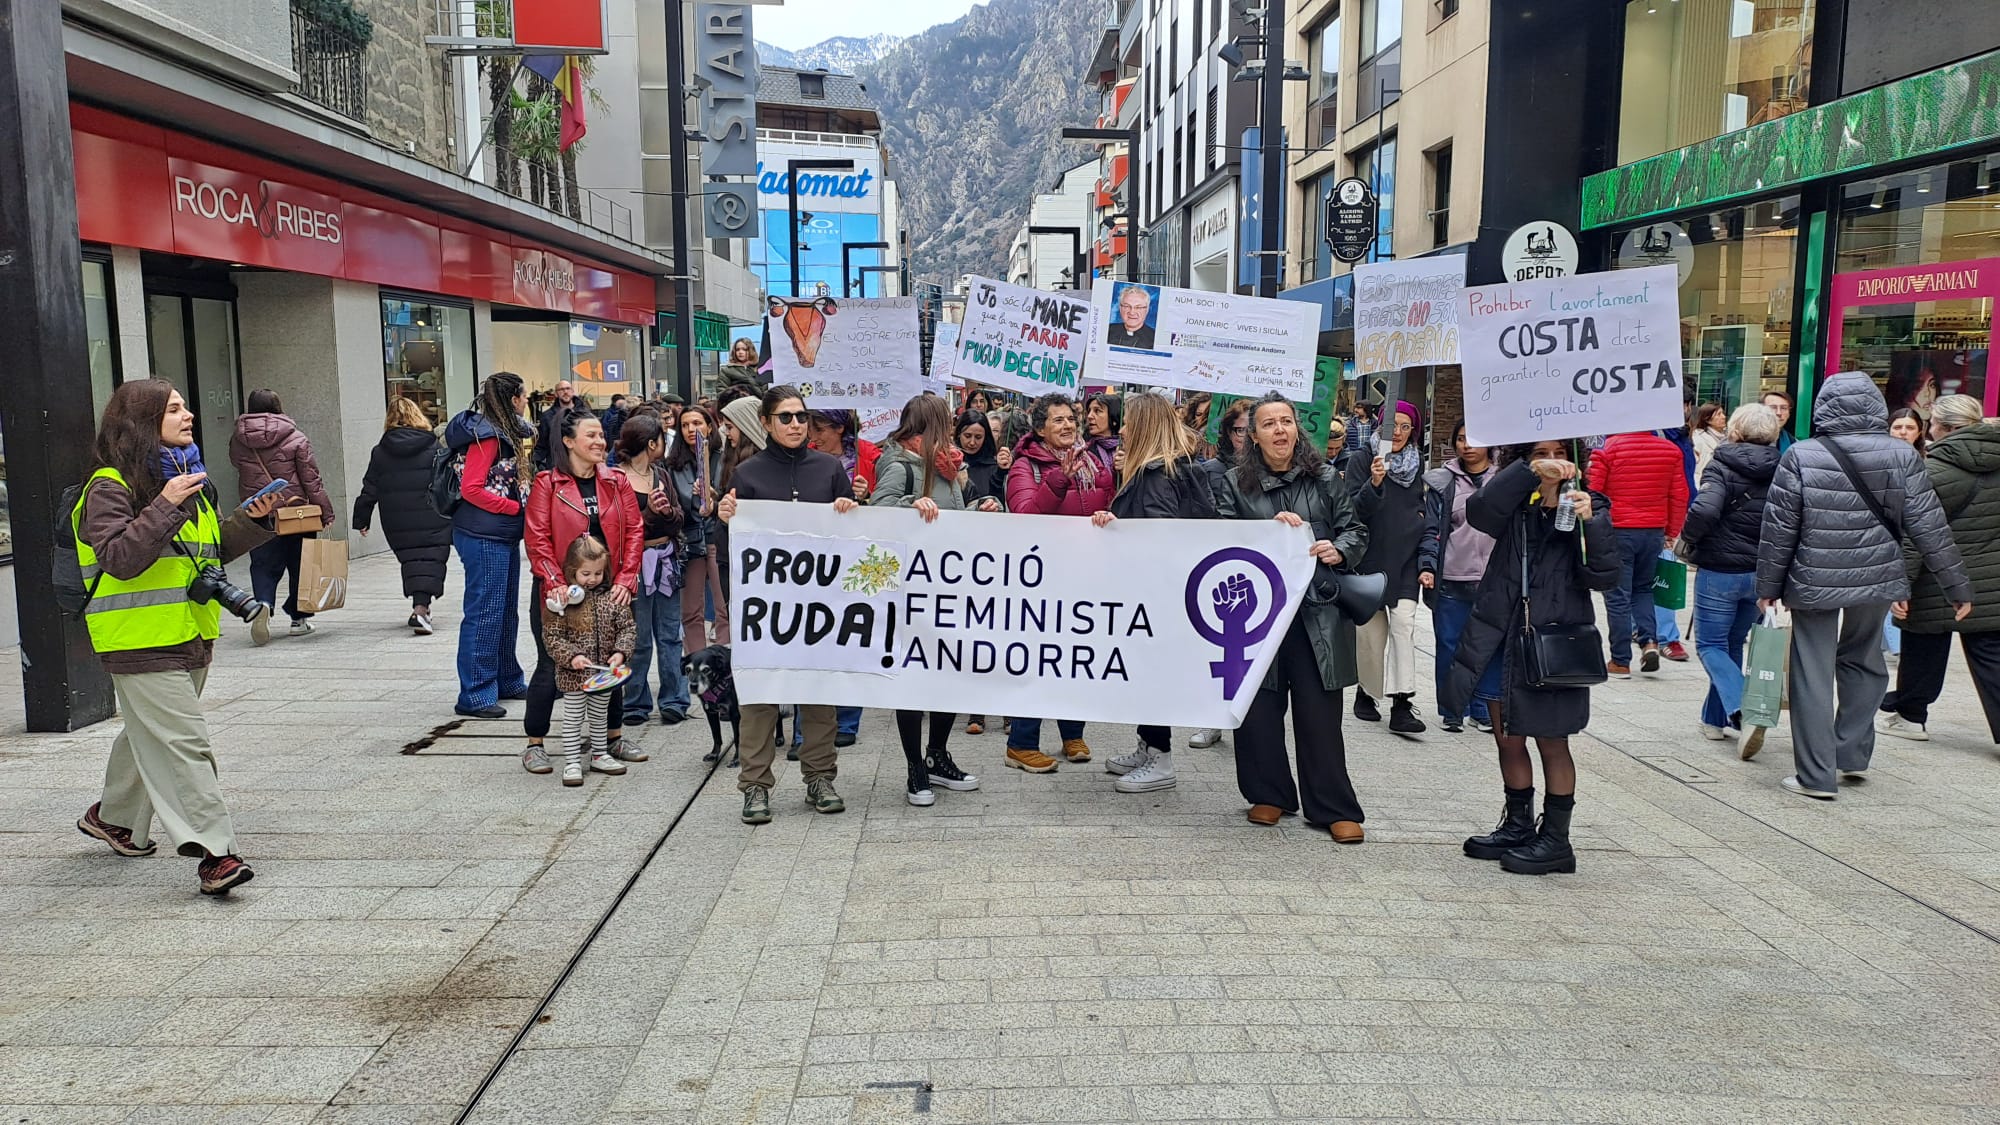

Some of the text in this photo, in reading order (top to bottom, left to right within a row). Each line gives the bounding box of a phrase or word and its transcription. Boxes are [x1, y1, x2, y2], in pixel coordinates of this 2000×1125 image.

[705, 9, 747, 142] STAR
[1516, 266, 1564, 282] DEPOT
[1857, 269, 1978, 297] EMPORIO ARMANI
[893, 299, 912, 309] NO
[1174, 295, 1193, 305] NÚM
[1221, 302, 1230, 310] 10
[1408, 301, 1431, 327] NO
[1469, 281, 1649, 316] Prohibir l'avortament
[981, 312, 997, 326] que
[998, 313, 1006, 325] la
[1021, 296, 1032, 312] la
[1031, 295, 1088, 334] MARE
[1185, 317, 1205, 328] JOAN
[1206, 320, 1230, 331] ENRIC
[1236, 324, 1258, 335] VIVES
[823, 332, 841, 343] EL
[848, 330, 892, 342] NOSTRE
[1008, 338, 1023, 350] que
[1230, 342, 1261, 352] Feminista
[1261, 344, 1286, 355] Andorra
[1499, 317, 1651, 359] COSTA drets
[1291, 369, 1304, 379] PER
[1572, 360, 1676, 395] COSTA
[1529, 395, 1597, 431] igualtat
[741, 543, 841, 587] PROU
[906, 545, 1044, 588] ACCIÓ
[906, 593, 1154, 637] FEMINISTA
[741, 597, 896, 669] RUDA!
[902, 637, 1129, 681] ANDORRA
